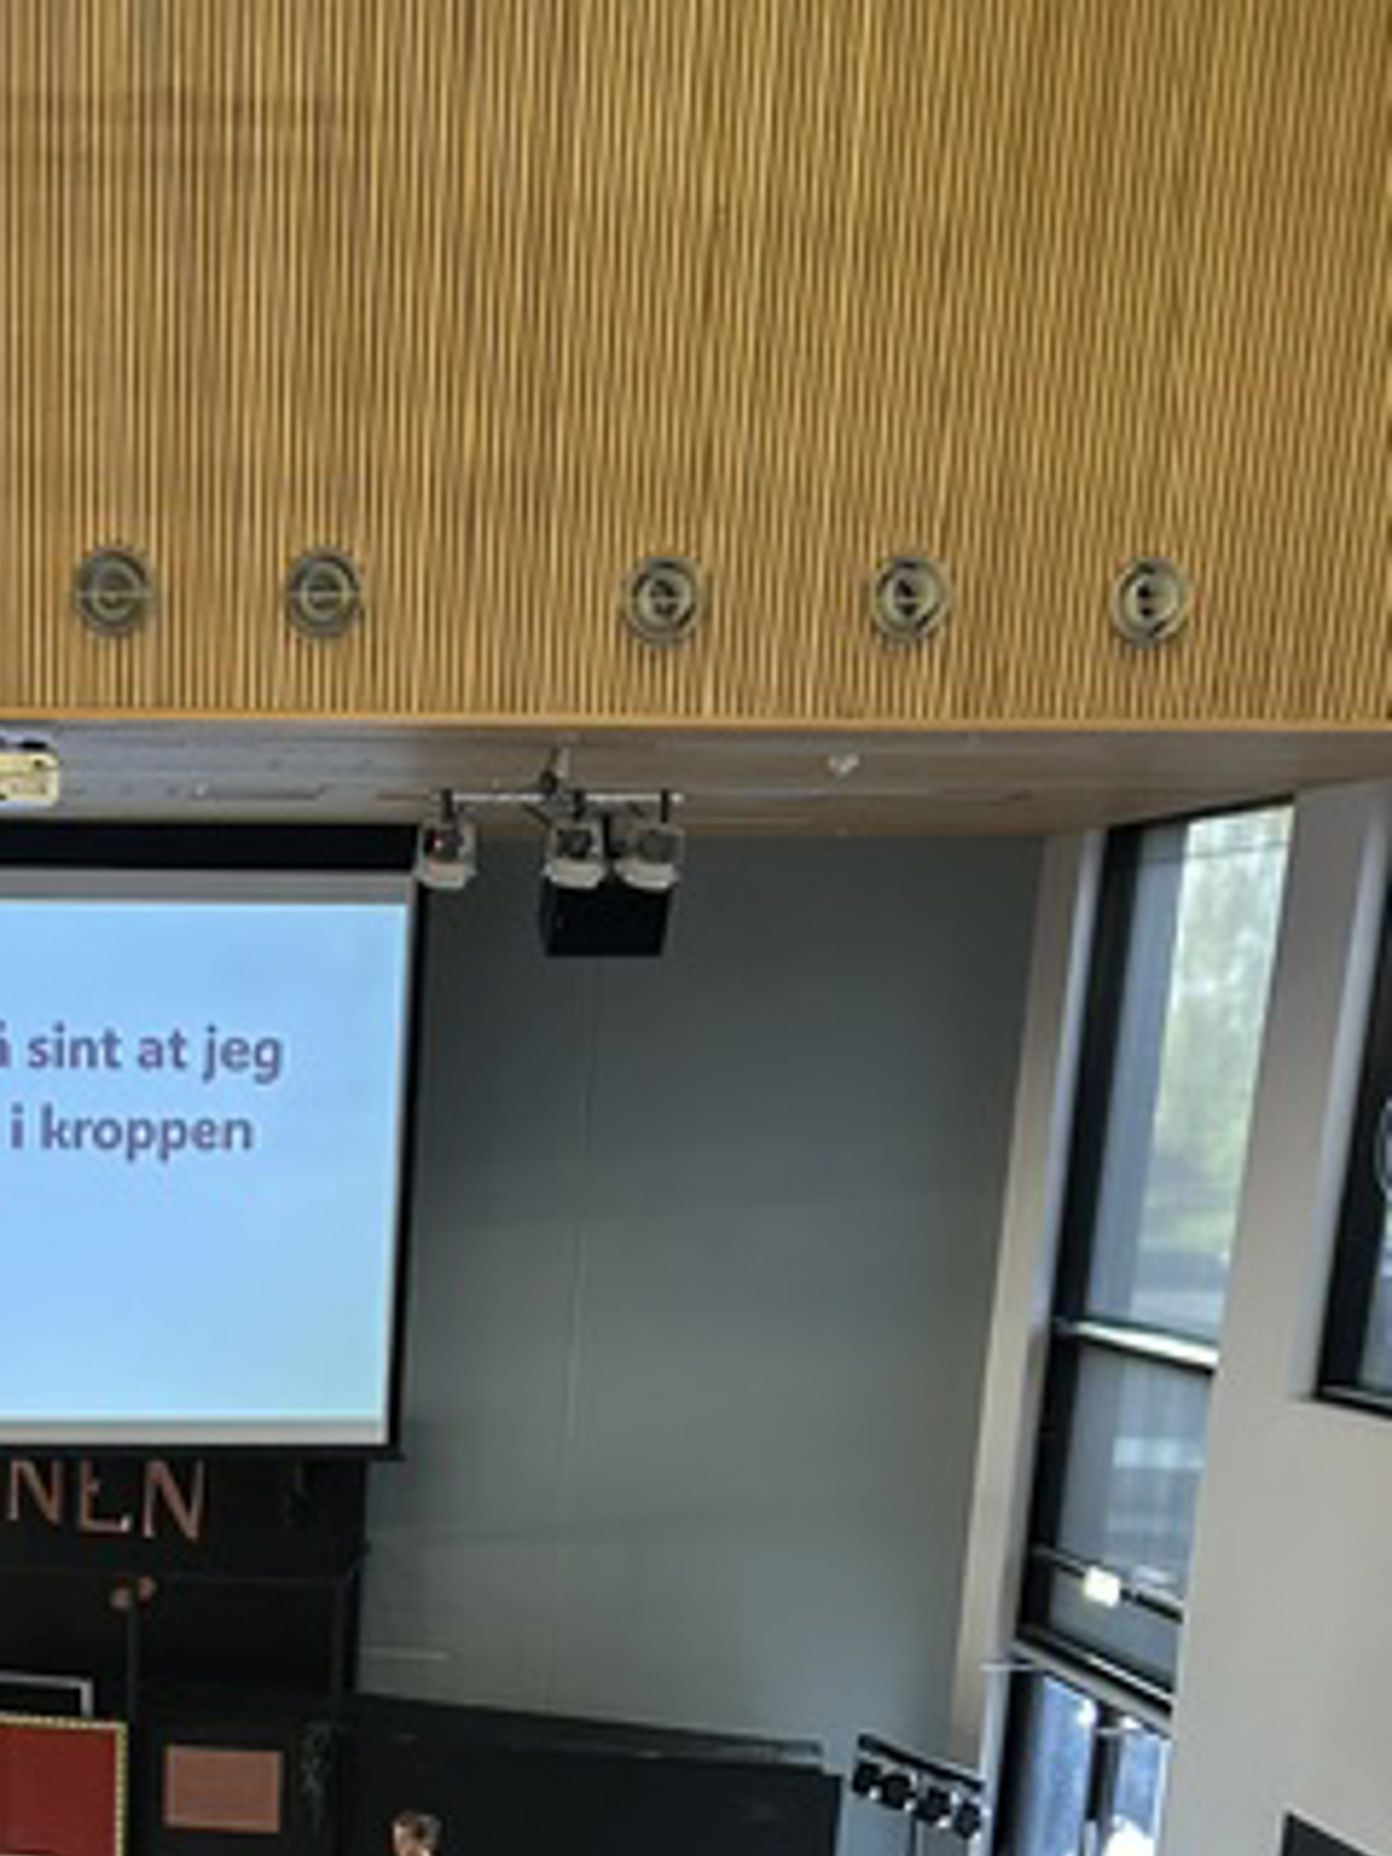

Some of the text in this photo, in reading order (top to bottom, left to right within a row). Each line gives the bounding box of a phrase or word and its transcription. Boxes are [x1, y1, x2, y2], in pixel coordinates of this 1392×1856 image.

[27, 1020, 122, 1068] sint
[137, 1029, 188, 1070] at
[202, 1024, 283, 1084] jeg
[10, 1102, 24, 1149] i
[40, 1102, 253, 1163] kroppen
